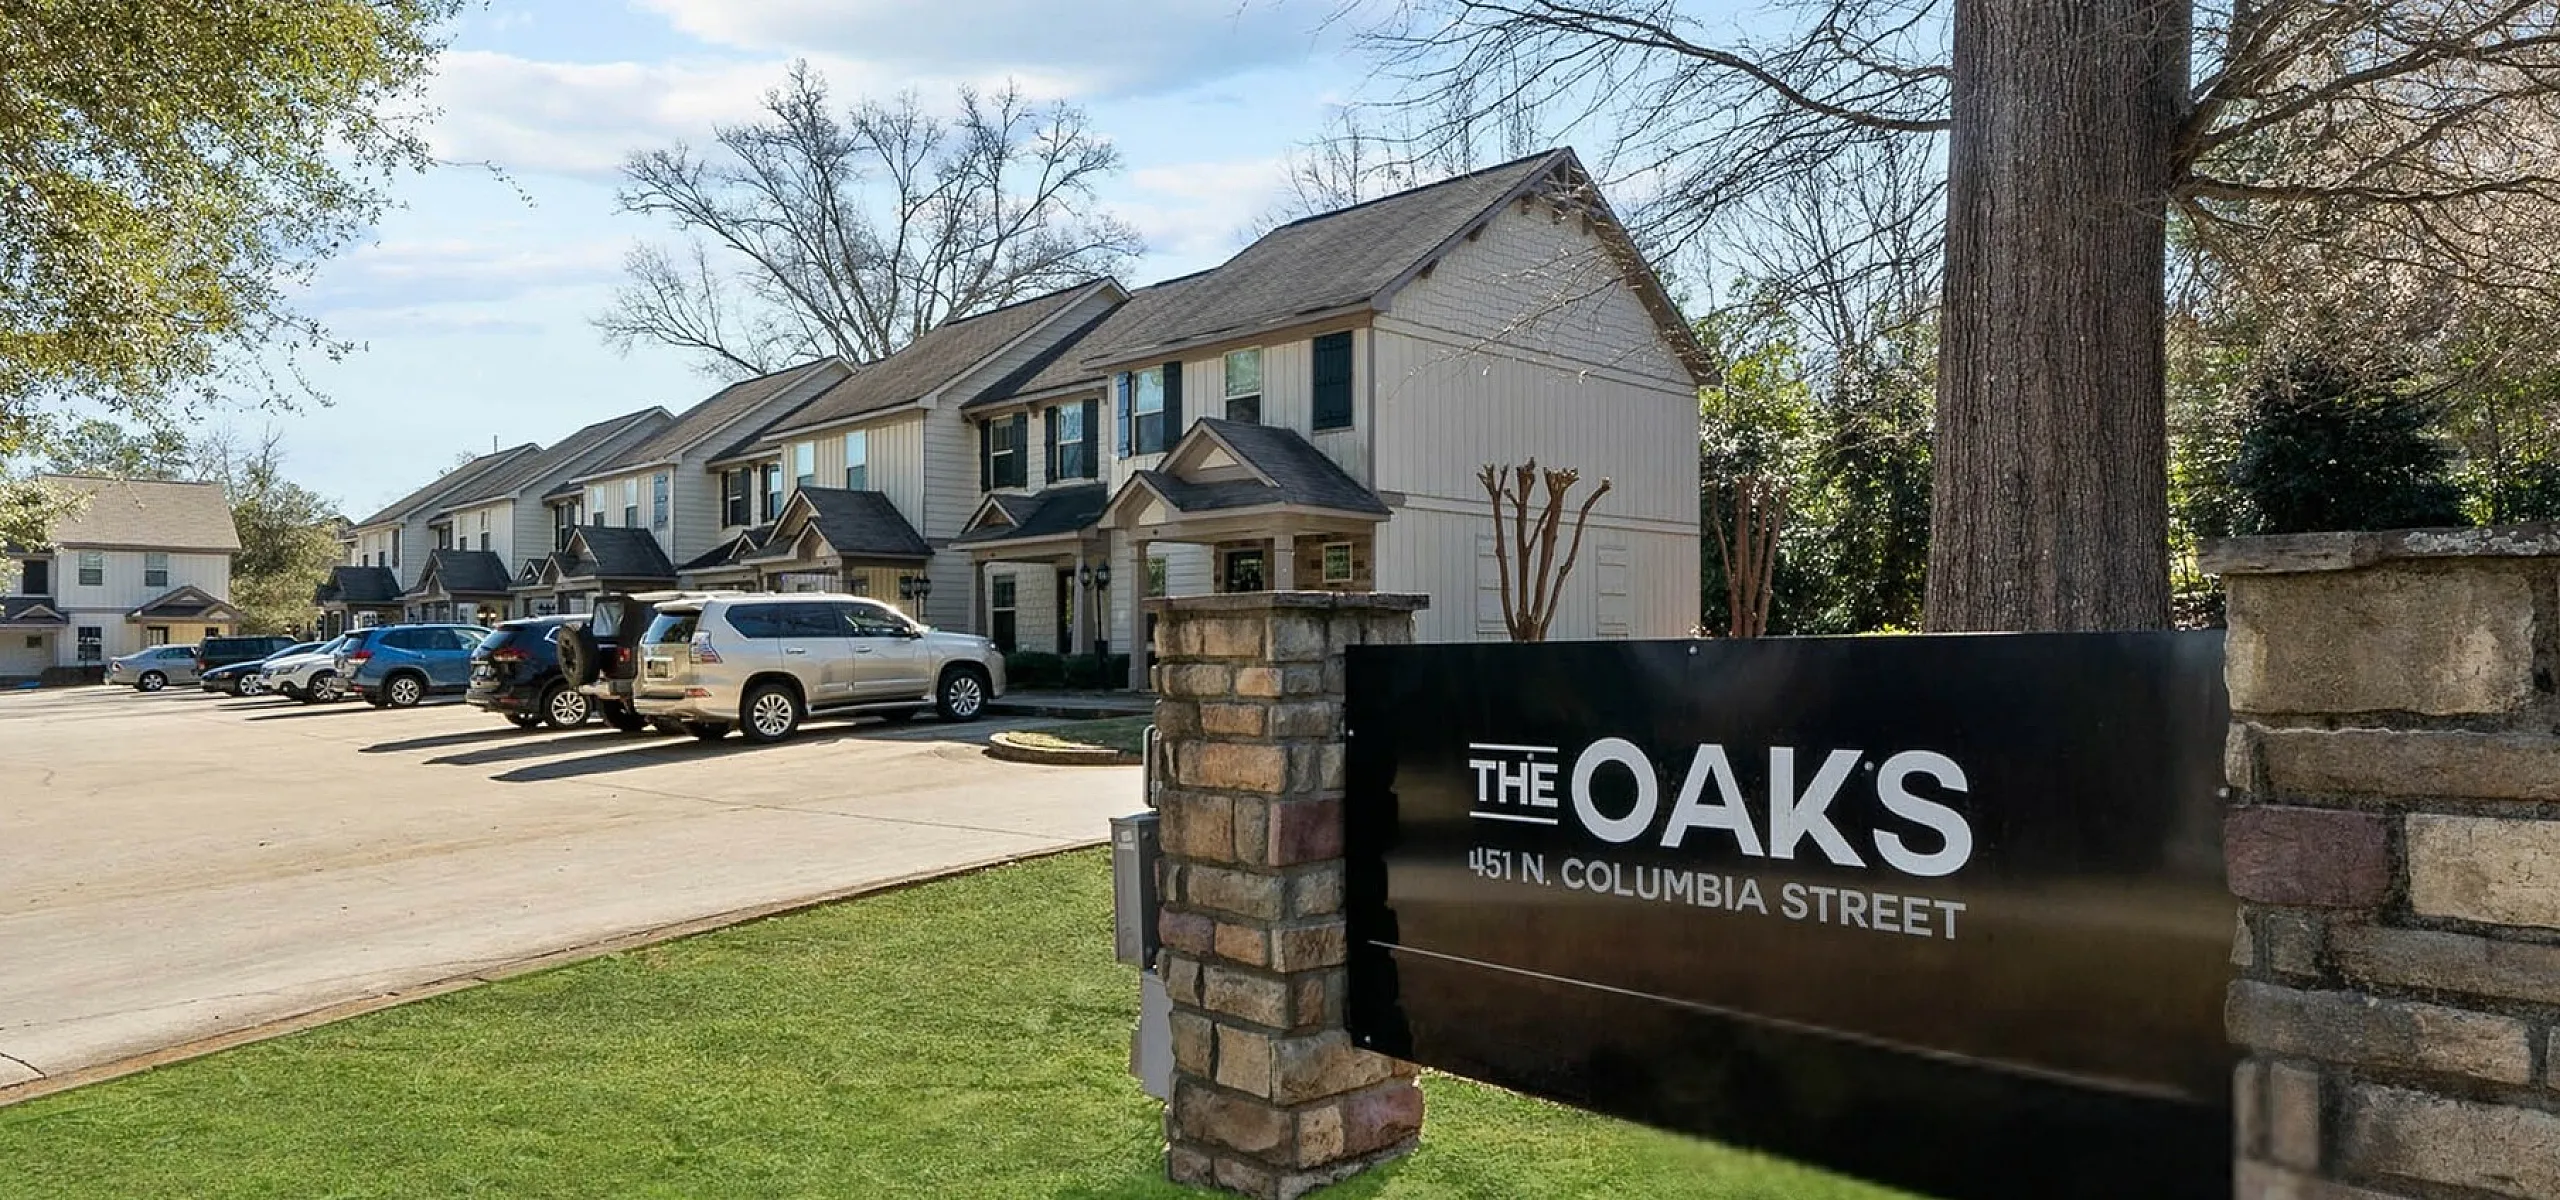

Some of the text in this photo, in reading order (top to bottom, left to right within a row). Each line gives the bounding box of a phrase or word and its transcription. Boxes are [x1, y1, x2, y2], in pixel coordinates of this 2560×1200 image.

[1469, 736, 1973, 877] THE OAKS
[1469, 847, 1967, 939] 451 N. COLUMBIA STREET
